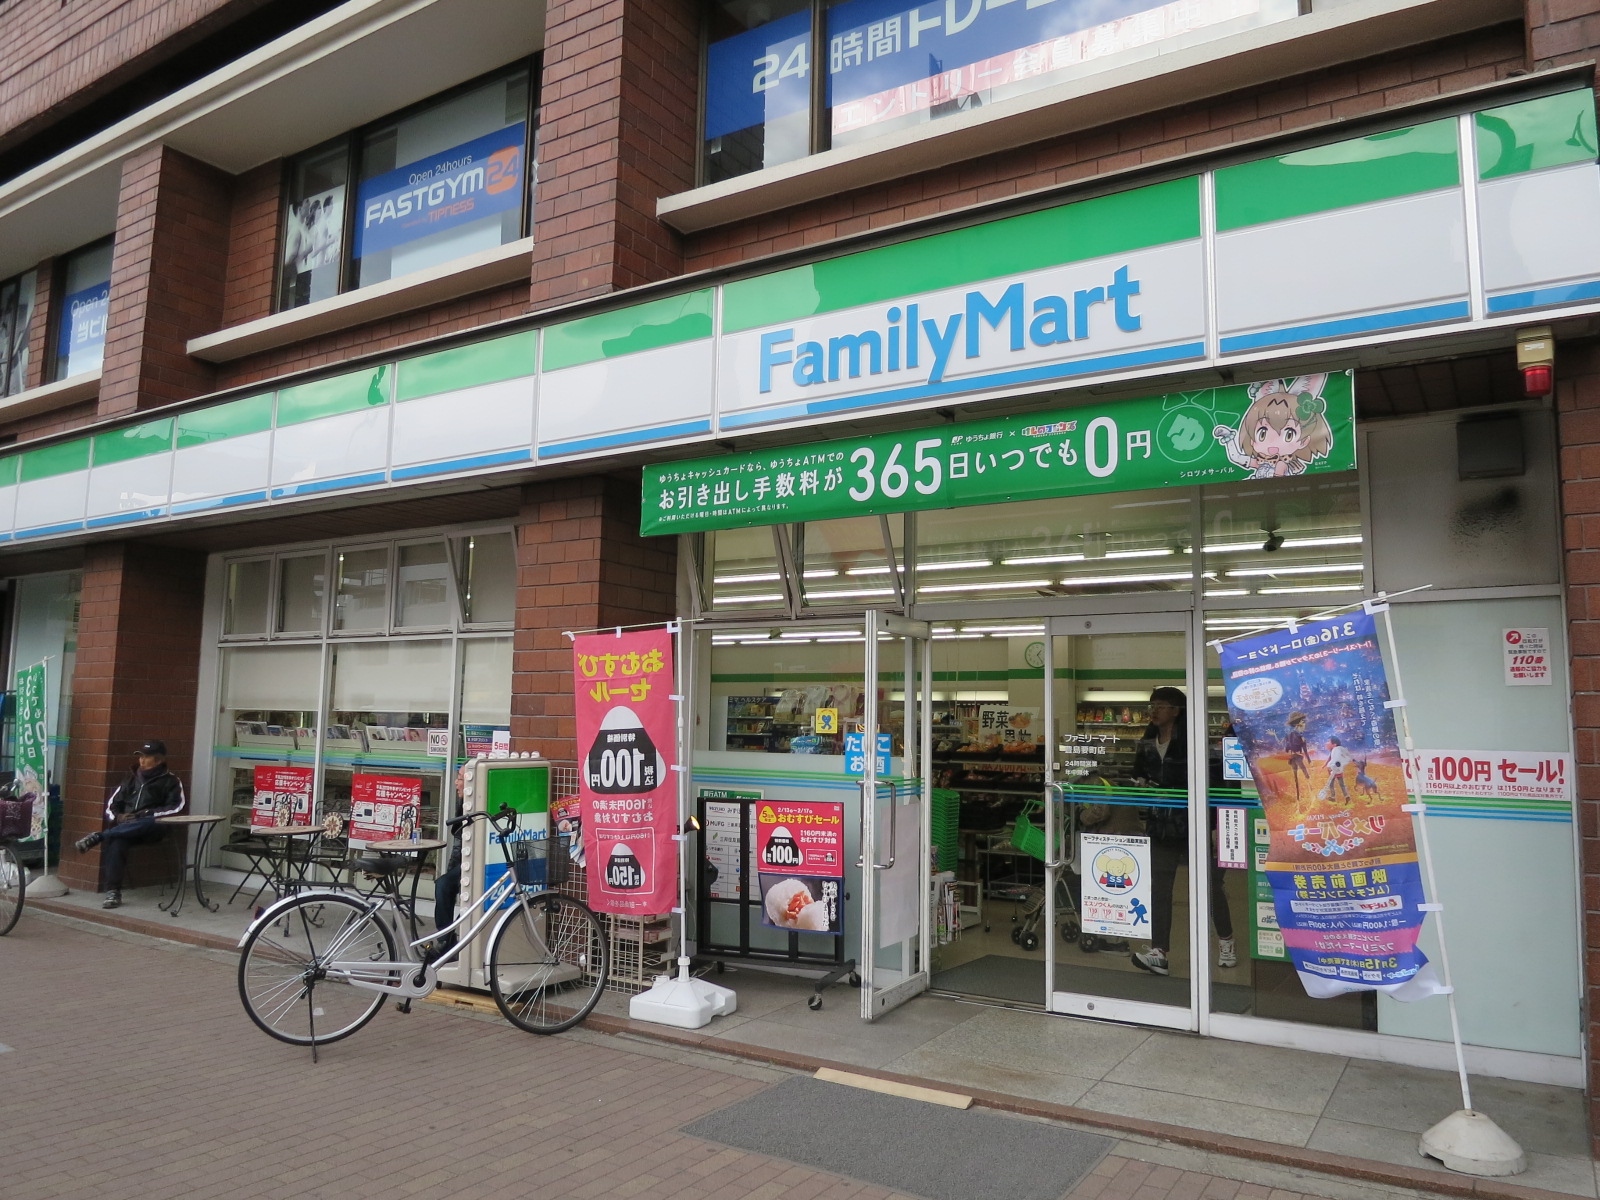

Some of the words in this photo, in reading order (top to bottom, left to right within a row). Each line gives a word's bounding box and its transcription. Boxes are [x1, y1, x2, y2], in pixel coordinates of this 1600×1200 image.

[752, 42, 810, 94] 24
[408, 170, 433, 186] Open
[435, 155, 472, 176] 24hours
[365, 166, 484, 229] FASTGYM
[428, 198, 475, 223] TIPNESS
[759, 265, 1141, 394] FamilyMart
[965, 431, 1003, 443] ゆうちょ銀行
[659, 451, 844, 484] ゆうちょキャッシュカードなら、ゆうちょATMでの
[1179, 467, 1234, 478] シロツメサーバル
[1513, 655, 1544, 665] 110番
[982, 711, 1009, 729] 野菜
[430, 734, 439, 744] NO
[847, 735, 889, 752] たこ
[1064, 734, 1120, 744] ファミリーマート
[1497, 758, 1565, 785] セール!
[777, 813, 840, 825] おむすびセール
